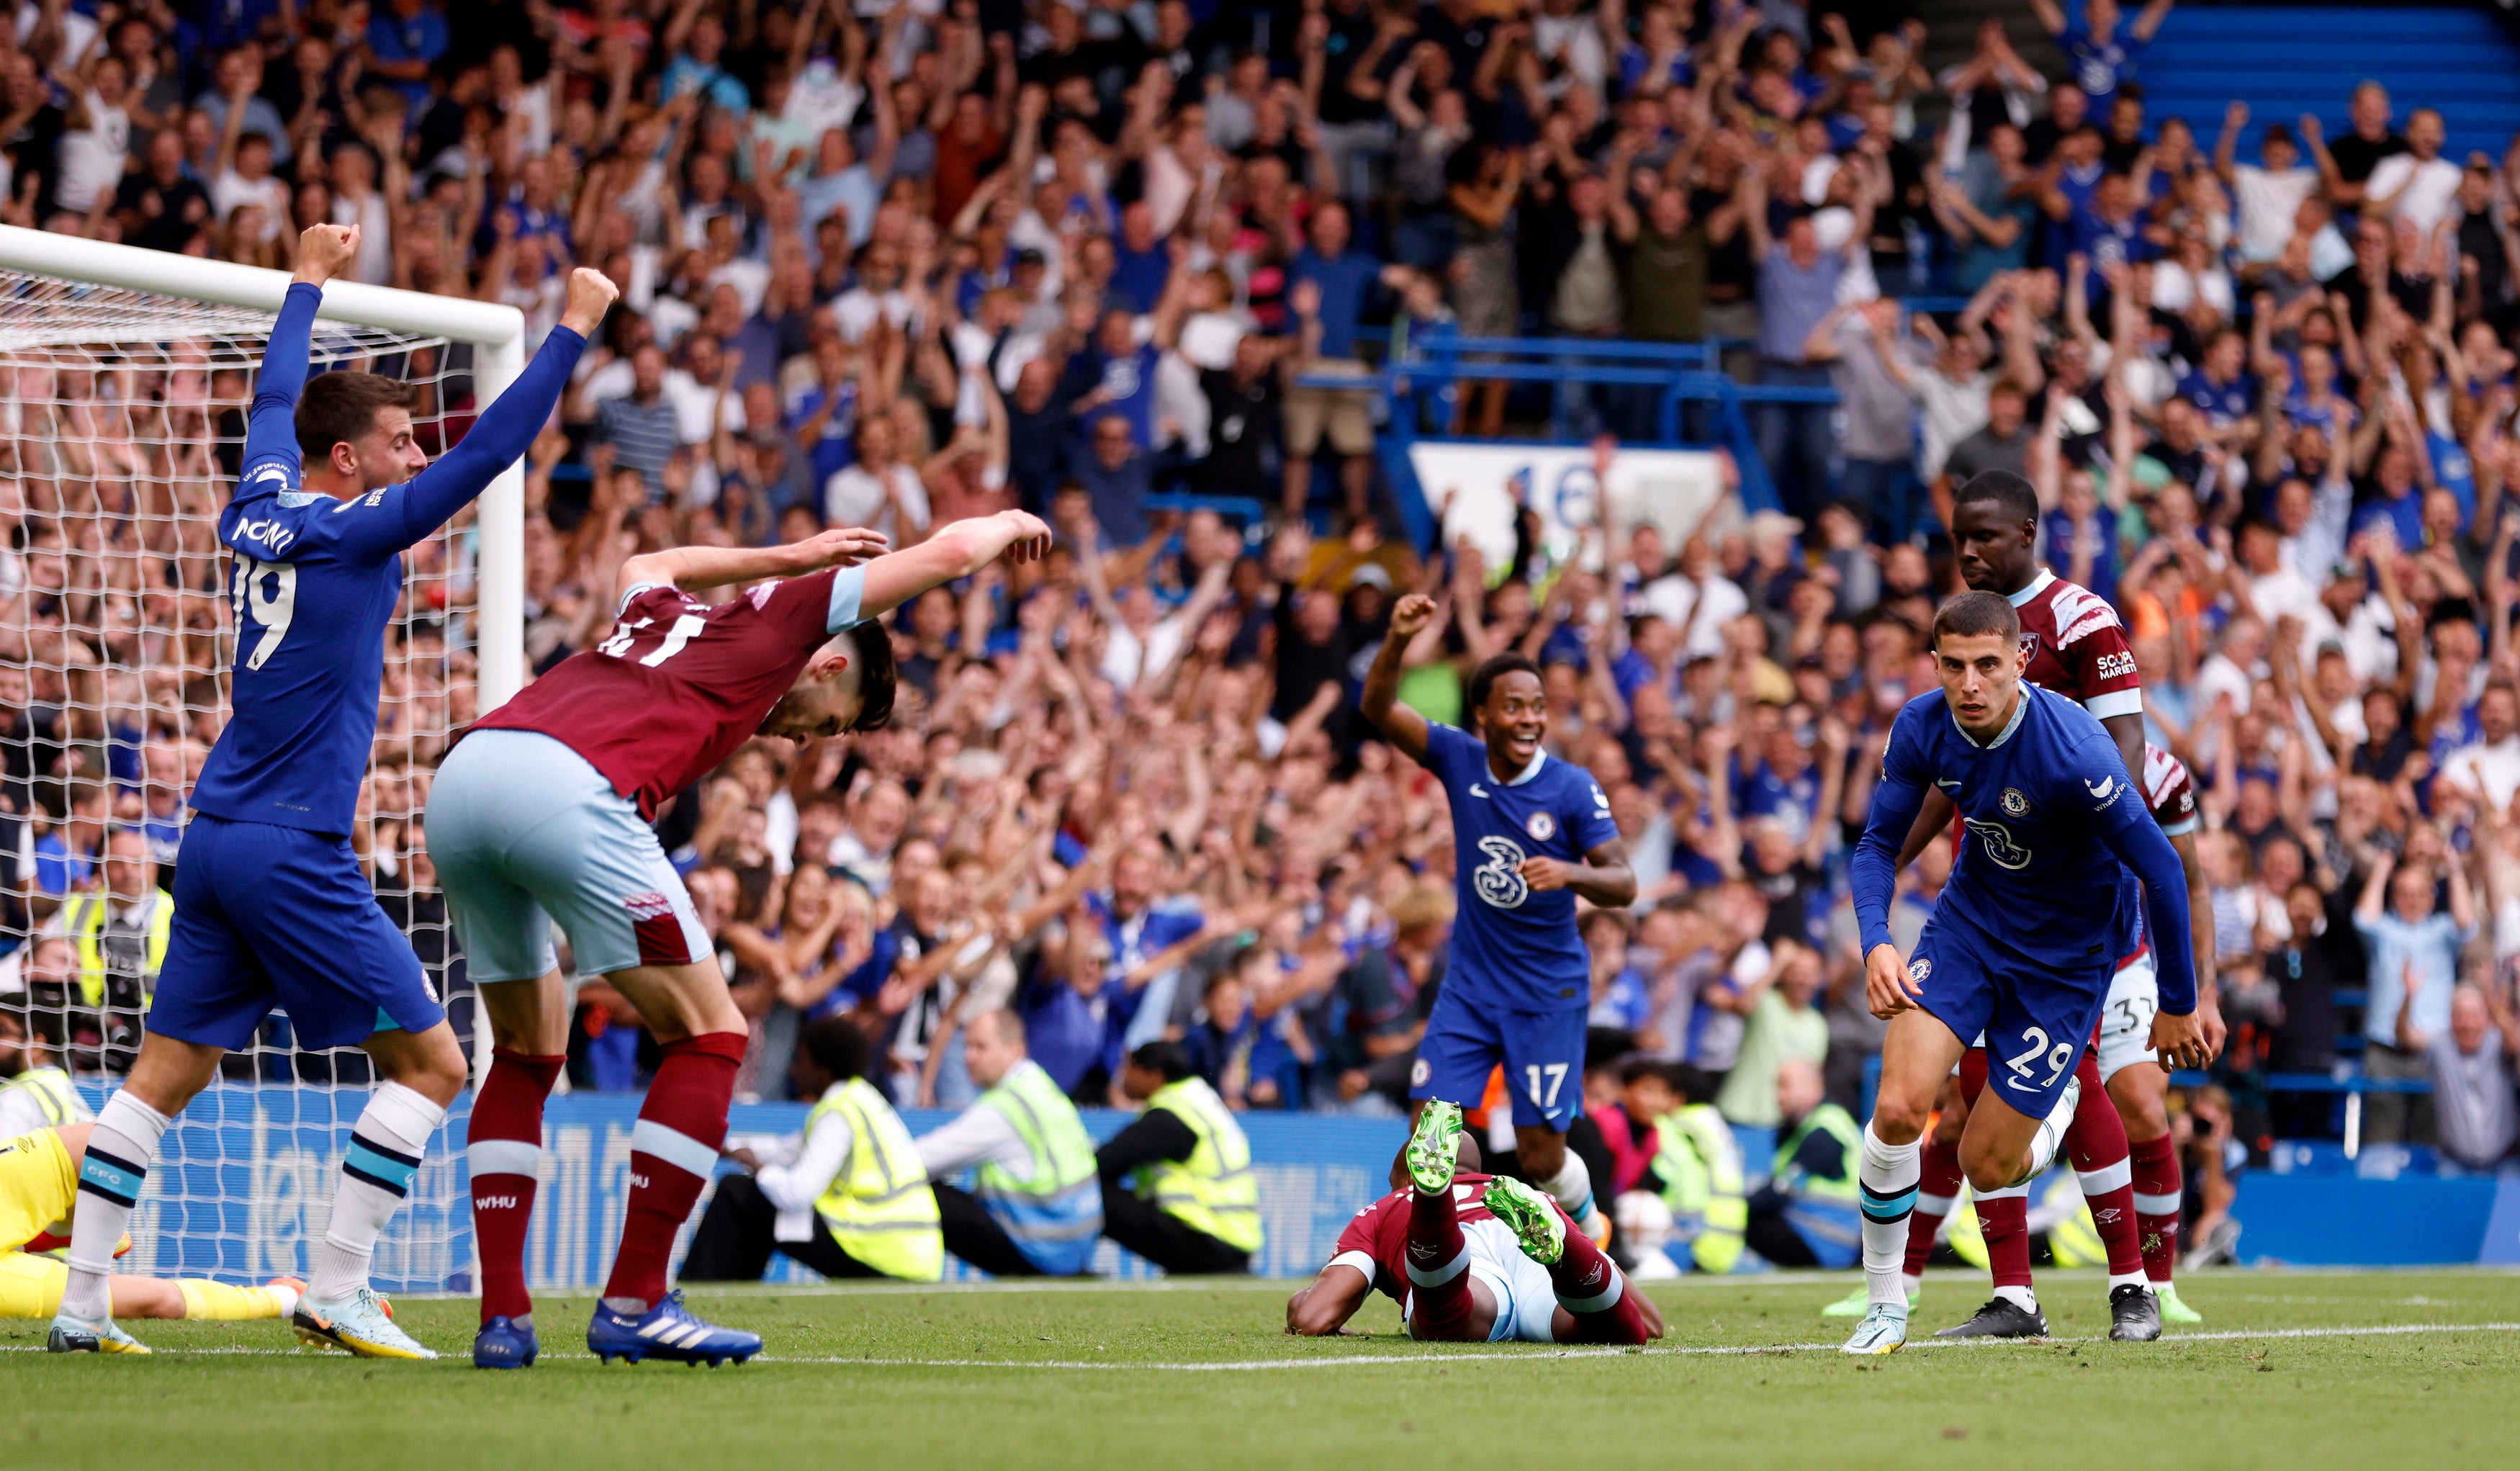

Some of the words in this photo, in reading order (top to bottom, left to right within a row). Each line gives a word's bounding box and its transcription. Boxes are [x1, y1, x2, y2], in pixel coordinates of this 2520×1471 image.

[232, 552, 297, 671] 19
[2097, 651, 2134, 670] SCOPE
[2100, 663, 2138, 680] MARKETS
[2094, 783, 2126, 811] WhaleFin
[2006, 1026, 2074, 1087] 29
[1526, 1062, 1569, 1108] 17
[476, 1195, 517, 1210] WHU
